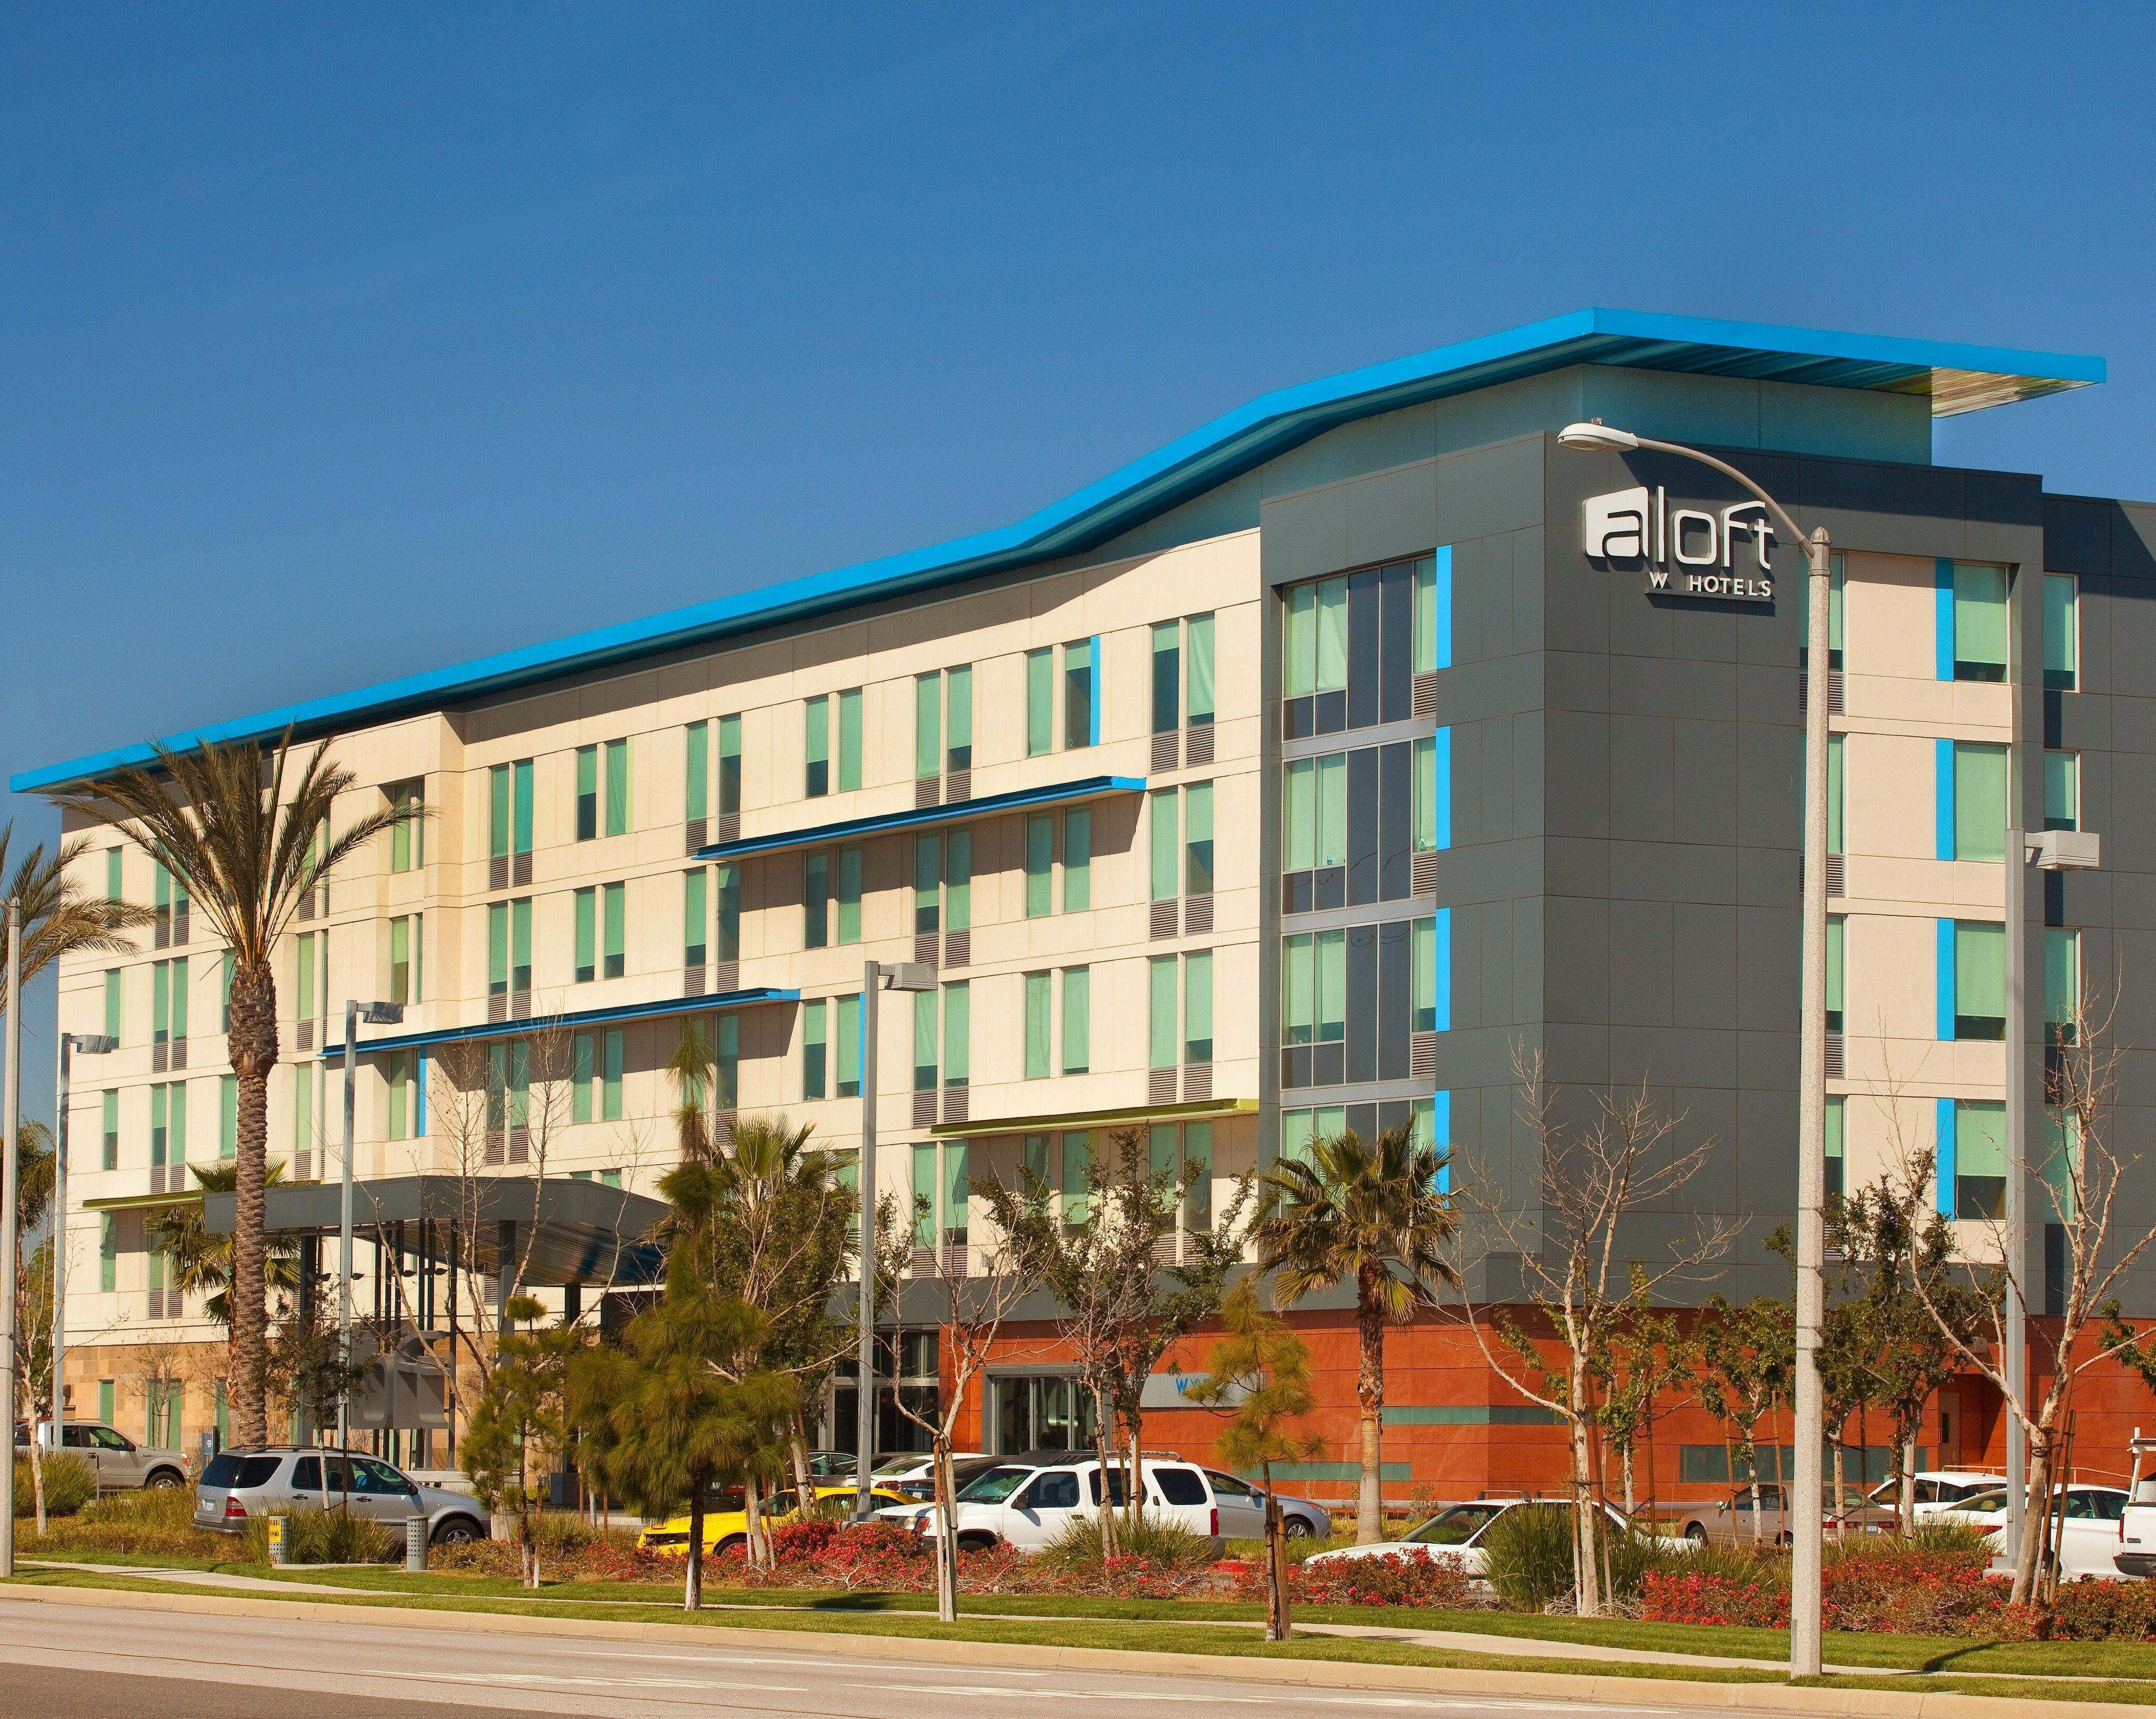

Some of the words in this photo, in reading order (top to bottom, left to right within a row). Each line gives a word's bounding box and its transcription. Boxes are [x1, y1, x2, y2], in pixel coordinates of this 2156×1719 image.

[1583, 485, 1774, 570] aloft
[1648, 571, 1669, 589] W
[1688, 574, 1771, 597] HOTELS
